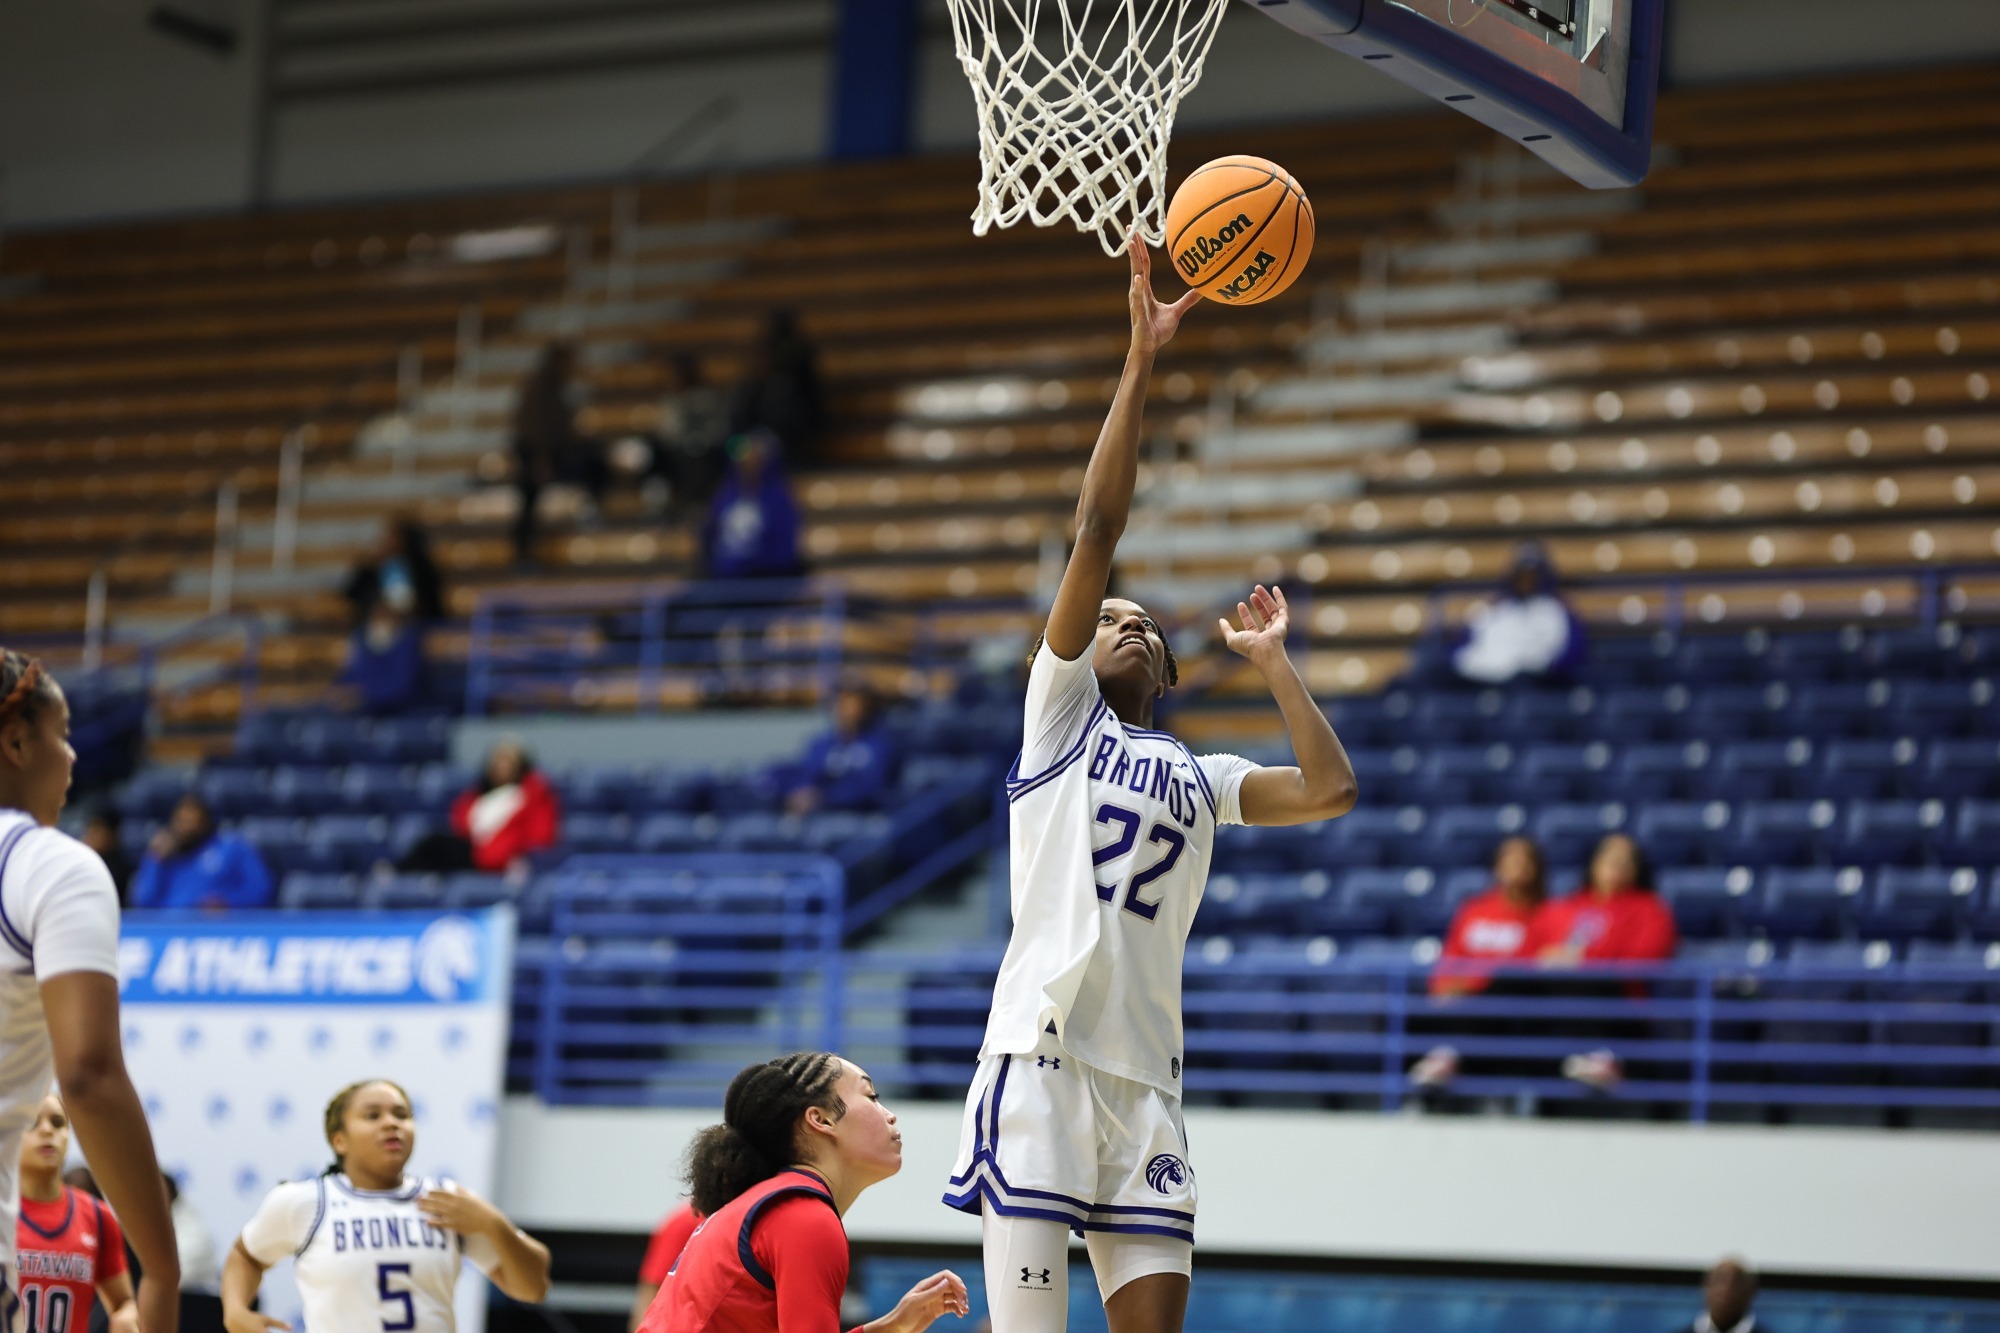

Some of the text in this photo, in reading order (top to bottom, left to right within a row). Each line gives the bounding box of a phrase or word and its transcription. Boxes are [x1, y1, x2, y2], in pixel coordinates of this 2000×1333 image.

[1177, 213, 1254, 278] Wilson
[1216, 250, 1277, 300] NCAA
[1088, 733, 1197, 829] BRONOS
[1091, 802, 1186, 923] 22
[119, 937, 414, 996] F ATHLETICS
[22, 1283, 75, 1333] 10
[376, 1262, 417, 1332] 5
